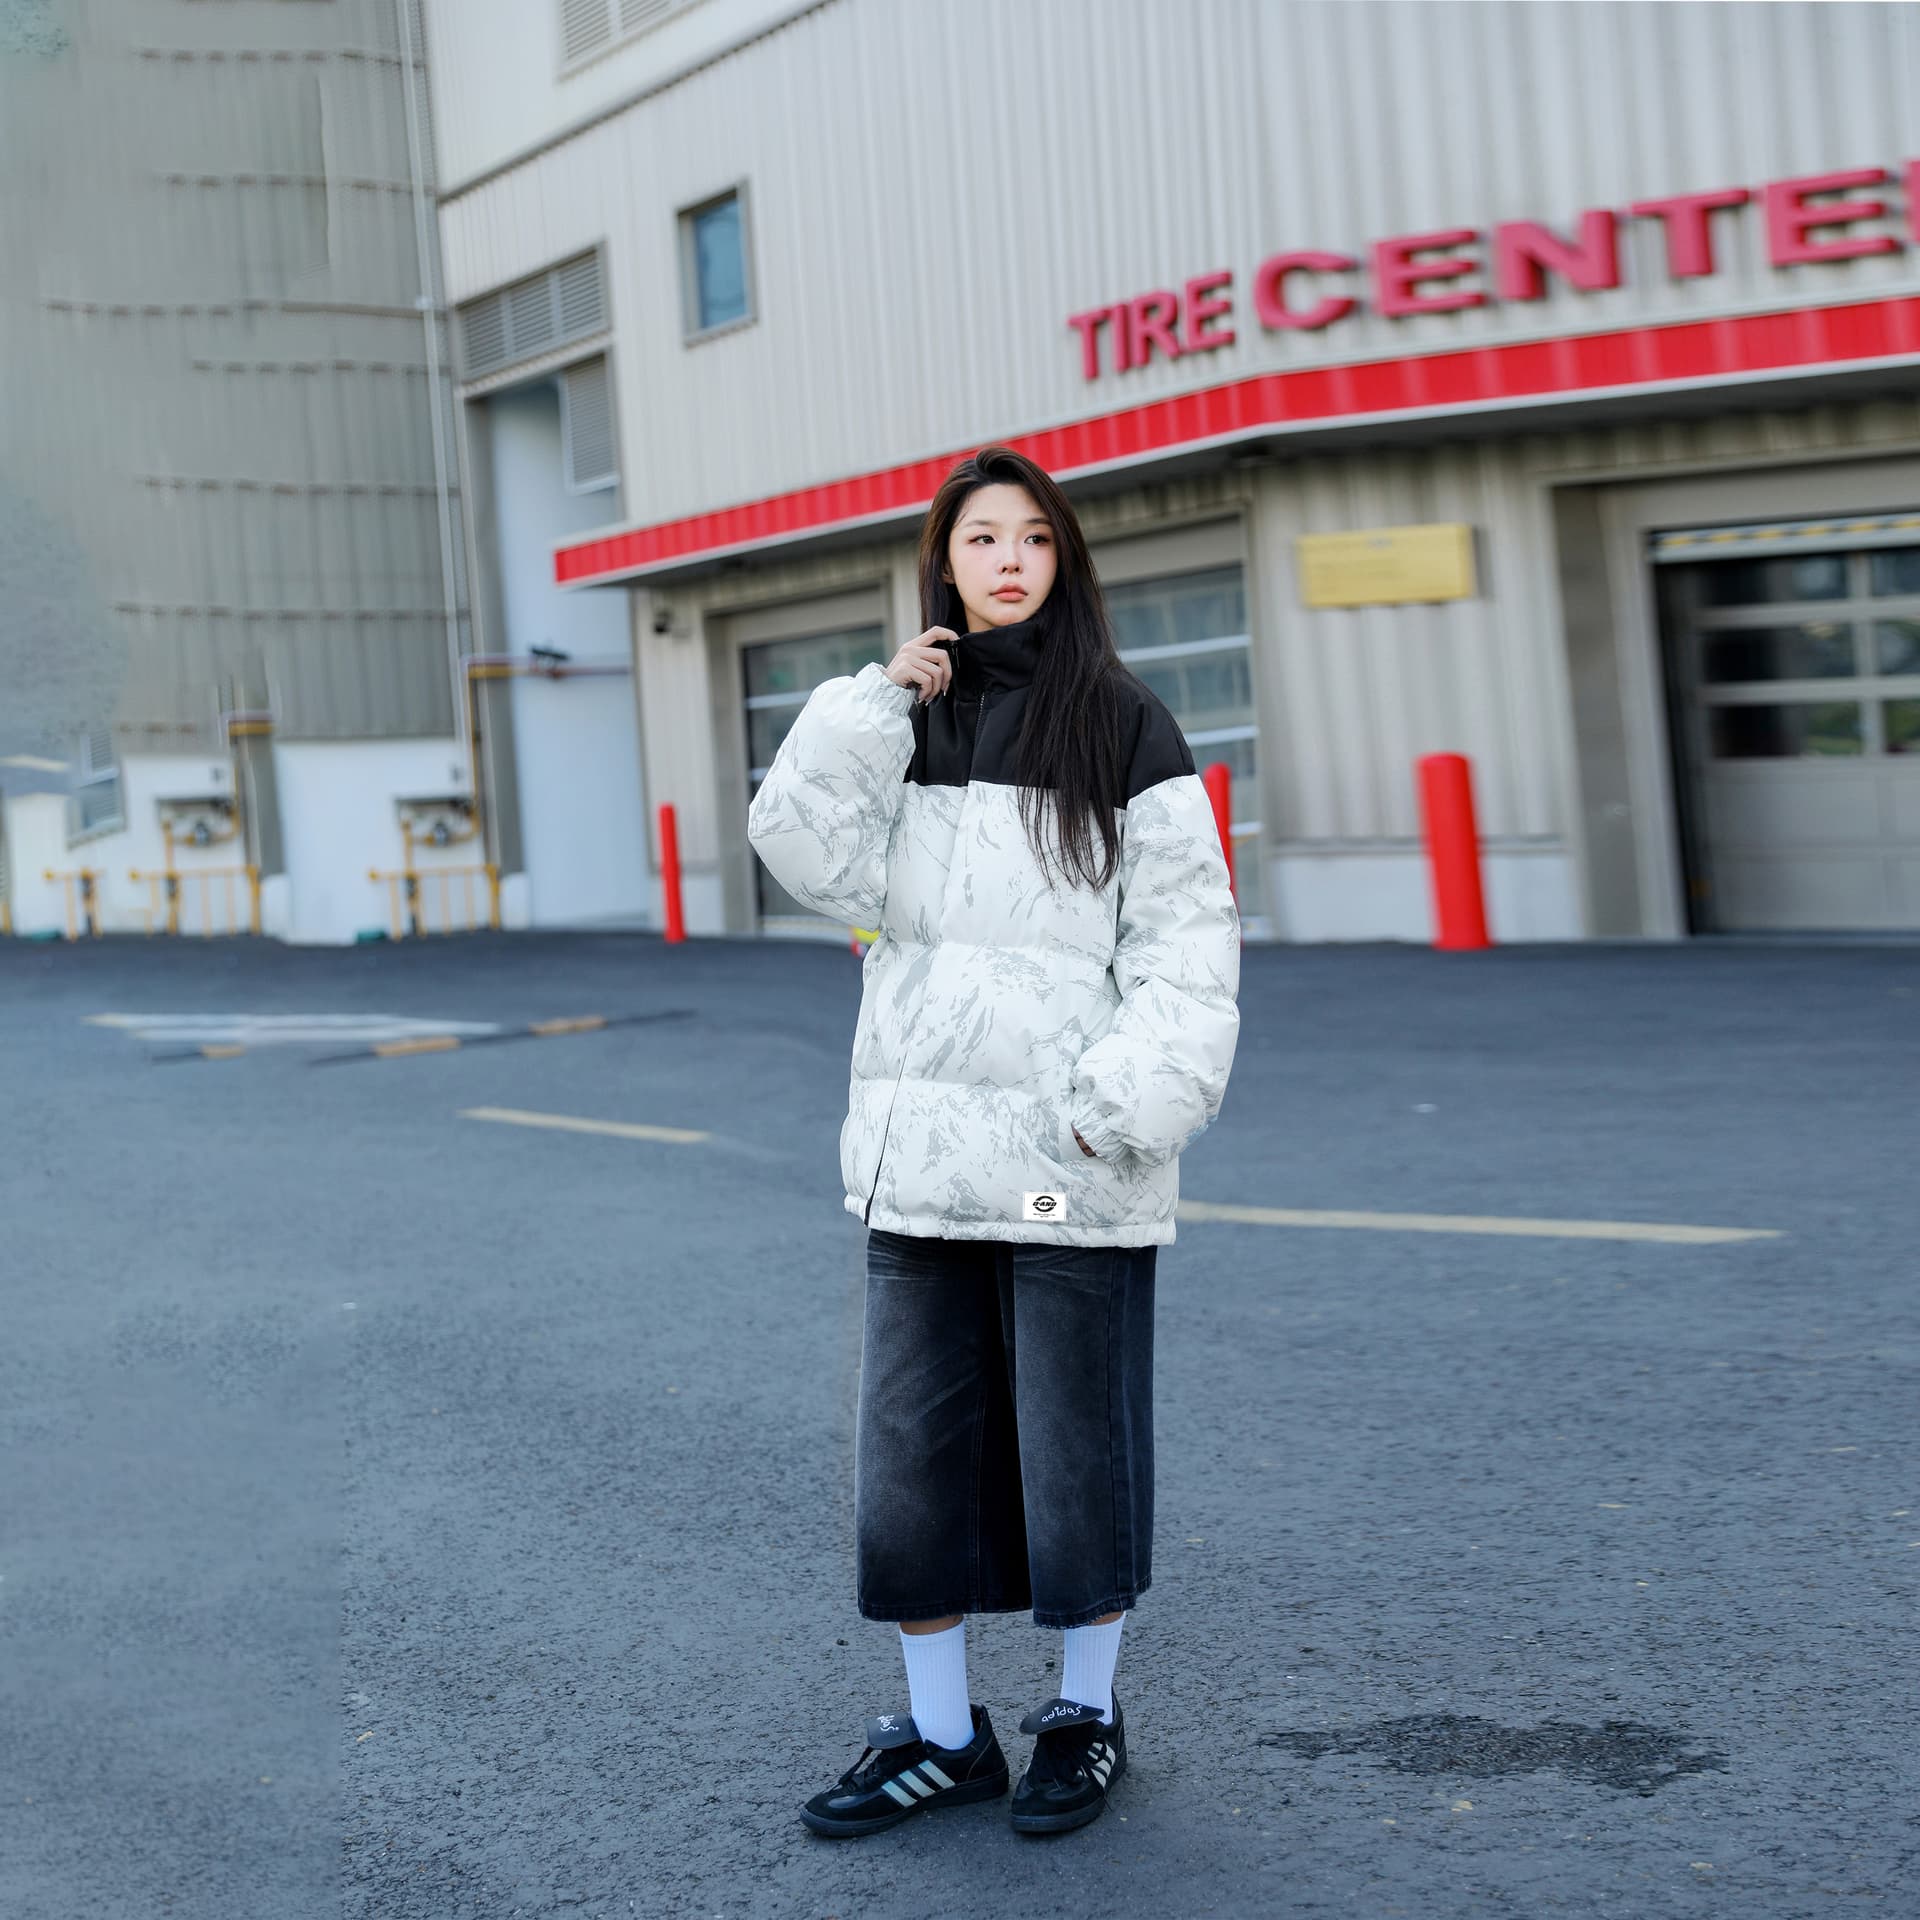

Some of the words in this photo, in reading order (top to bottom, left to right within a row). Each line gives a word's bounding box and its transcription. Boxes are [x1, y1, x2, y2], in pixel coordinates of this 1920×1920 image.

[1068, 271, 1235, 381] TIRE
[1253, 156, 1920, 332] CENTE
[1041, 1705, 1083, 1722] adidas
